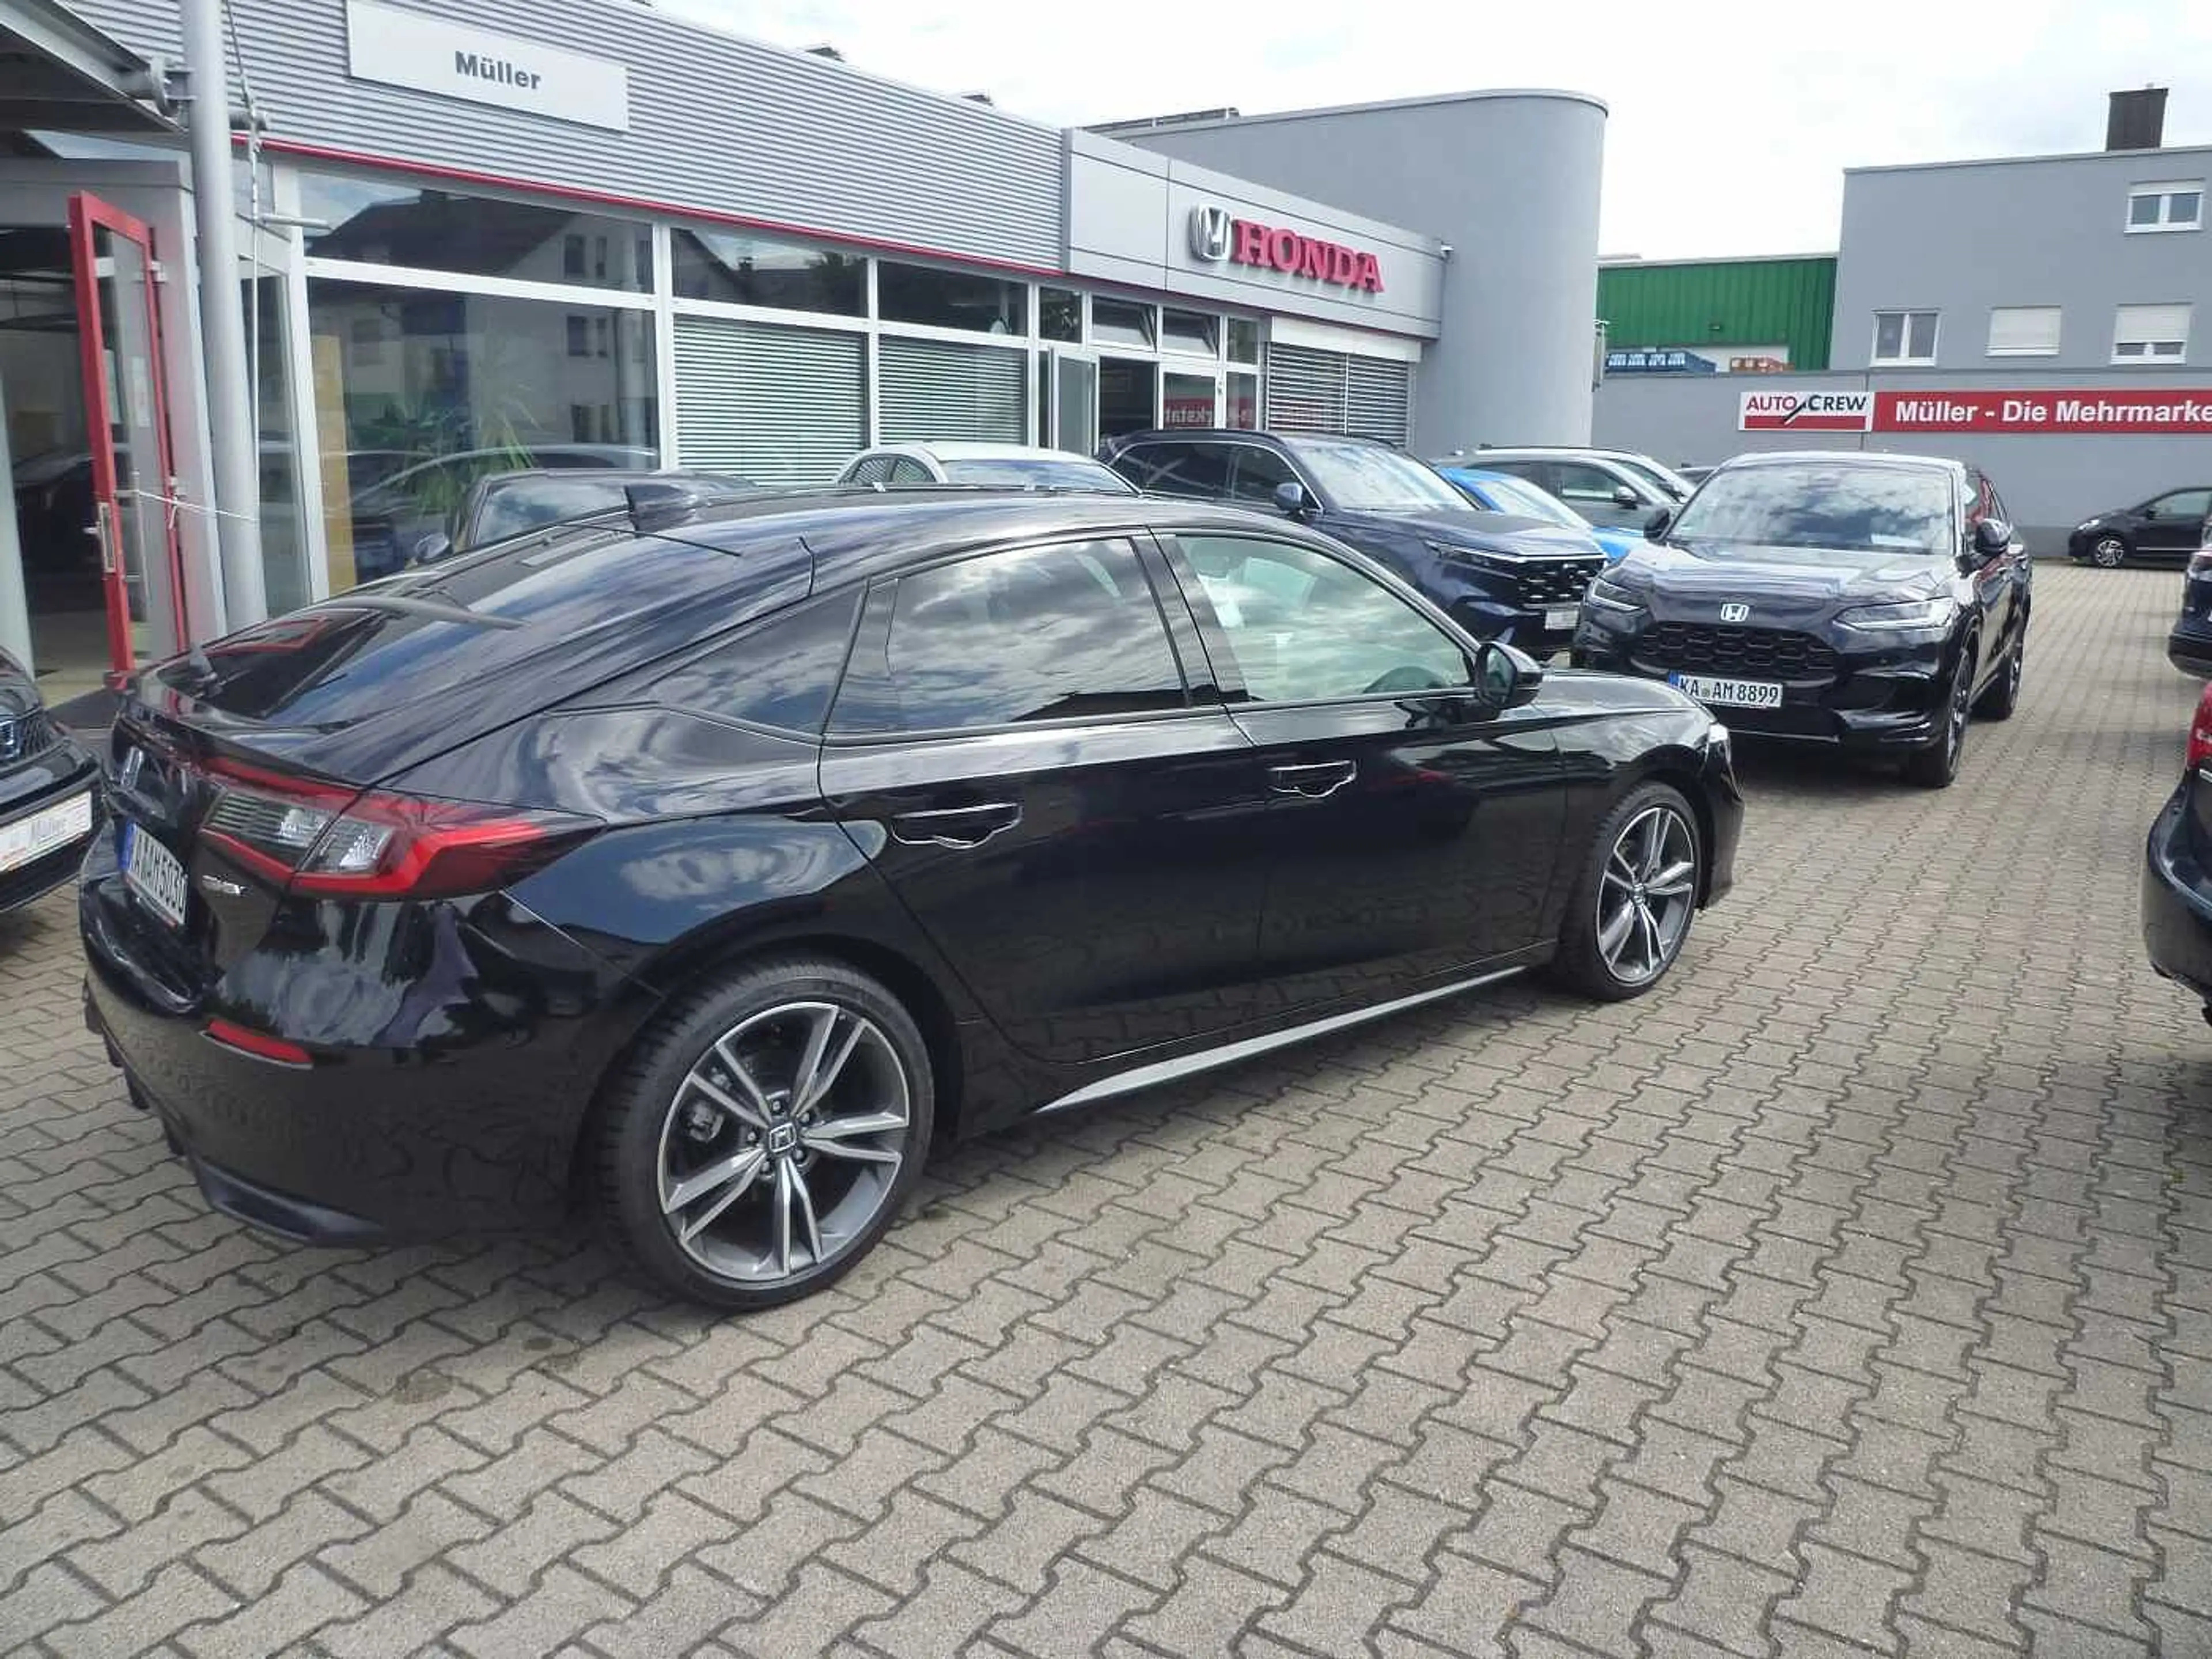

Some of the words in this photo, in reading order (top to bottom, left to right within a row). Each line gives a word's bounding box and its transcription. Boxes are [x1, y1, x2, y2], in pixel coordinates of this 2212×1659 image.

[455, 51, 541, 89] Müller
[1230, 218, 1384, 293] HONDA
[1746, 396, 1797, 410] AUTO
[1808, 395, 1866, 410] CREW
[1896, 401, 1978, 422] Müller
[2002, 400, 2047, 421] Die
[2056, 400, 2212, 422] Mehrmarke
[1713, 682, 1733, 699] AM
[1737, 684, 1778, 703] 8899
